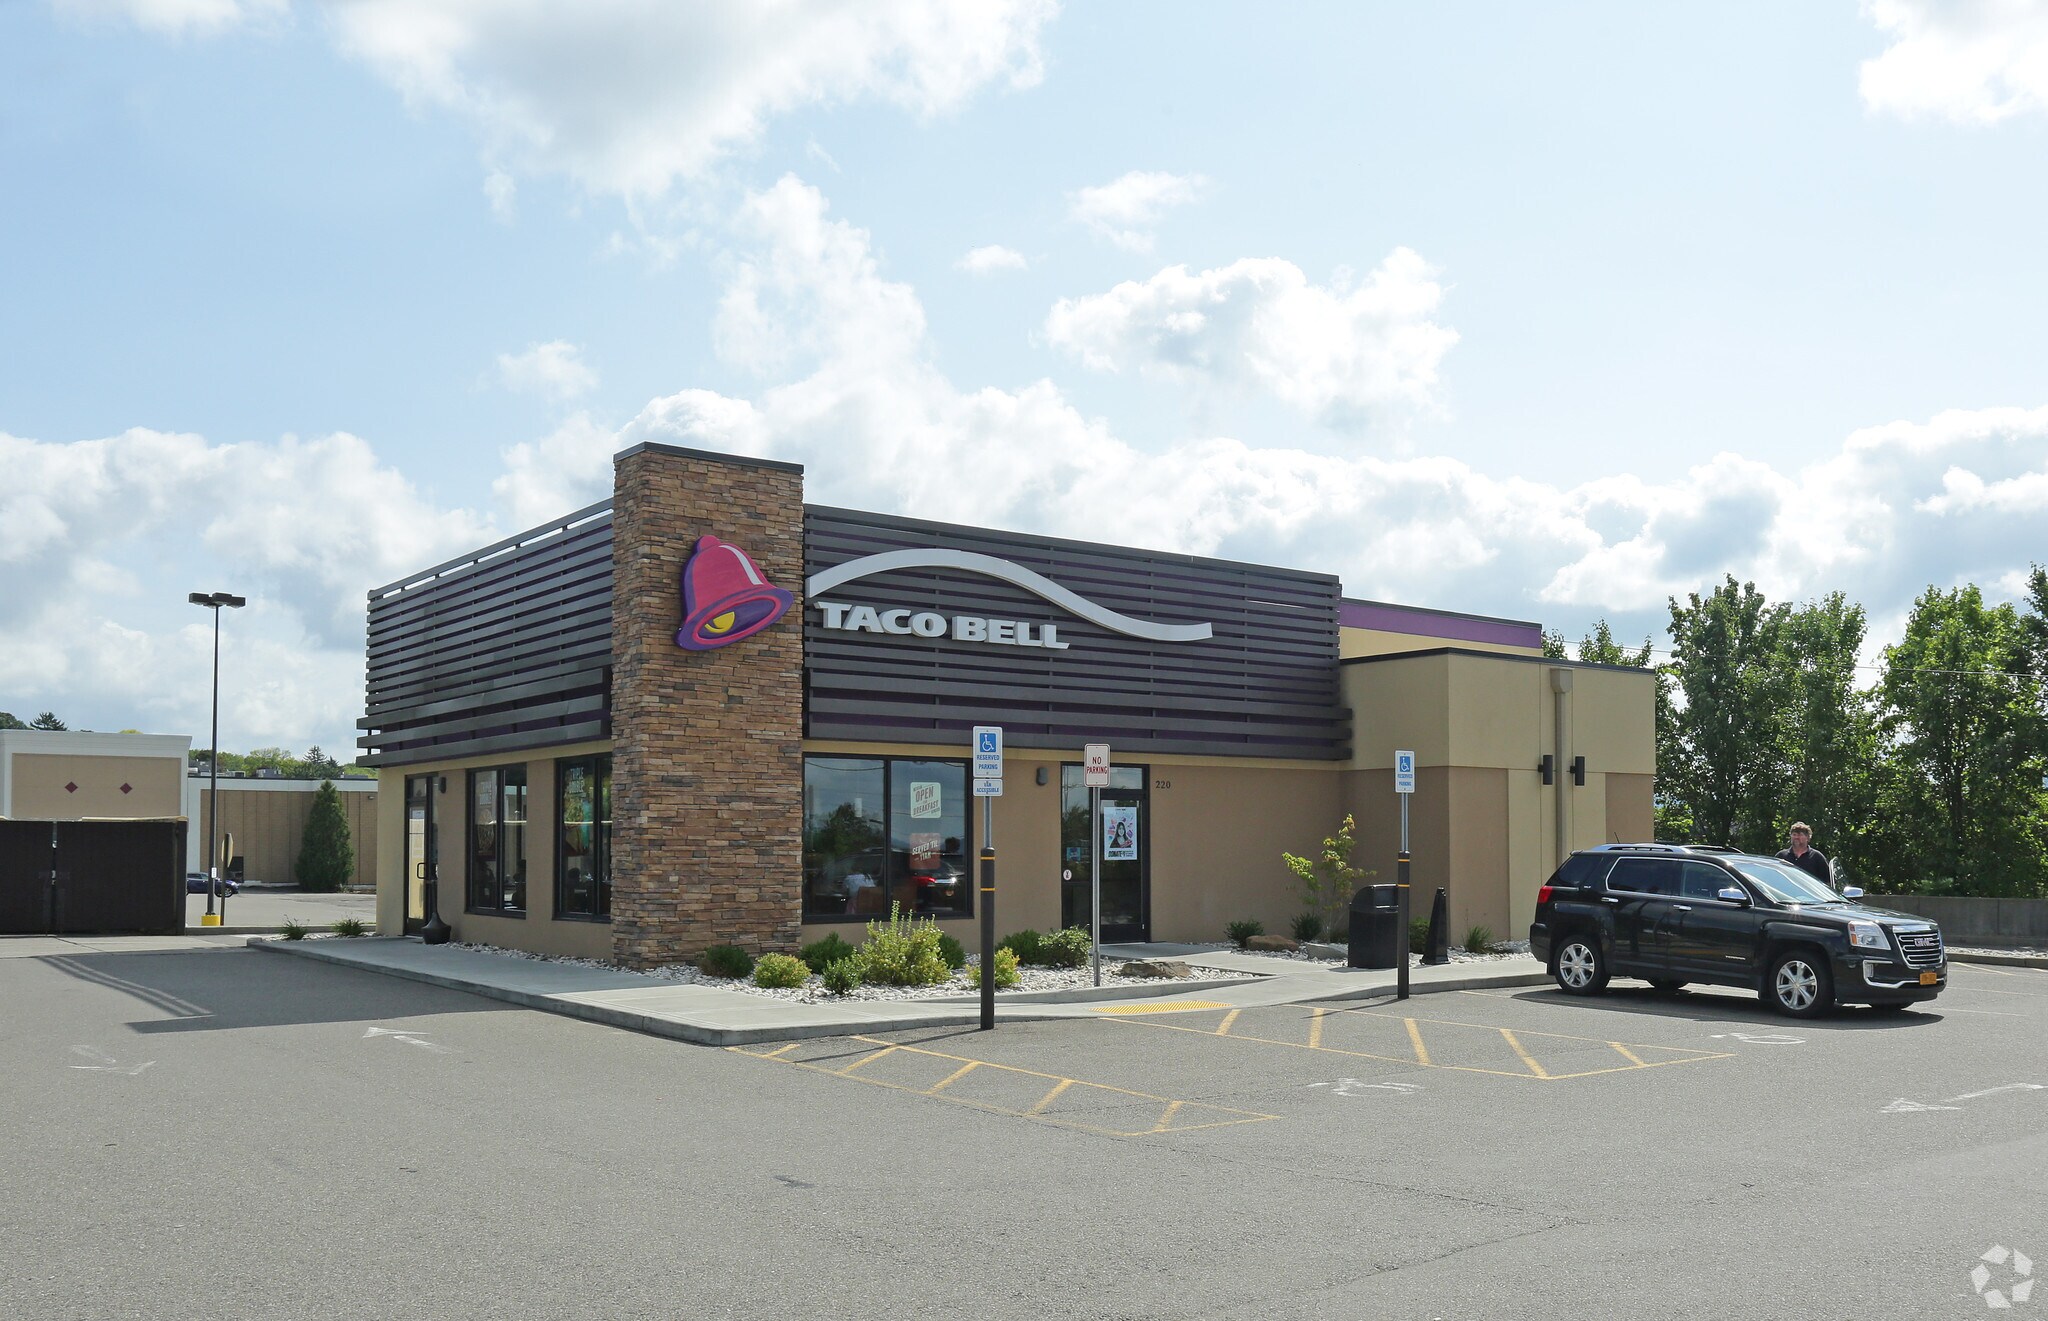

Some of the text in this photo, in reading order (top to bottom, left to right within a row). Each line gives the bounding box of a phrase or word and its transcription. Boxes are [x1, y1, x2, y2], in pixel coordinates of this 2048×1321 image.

[813, 601, 1071, 650] TACO BELL
[1092, 756, 1102, 765] NO
[1086, 766, 1108, 775] PARKING
[1155, 780, 1171, 789] 220
[915, 785, 934, 802] OPEN
[913, 799, 939, 815] BREAKFAST
[912, 842, 930, 855] SERVED
